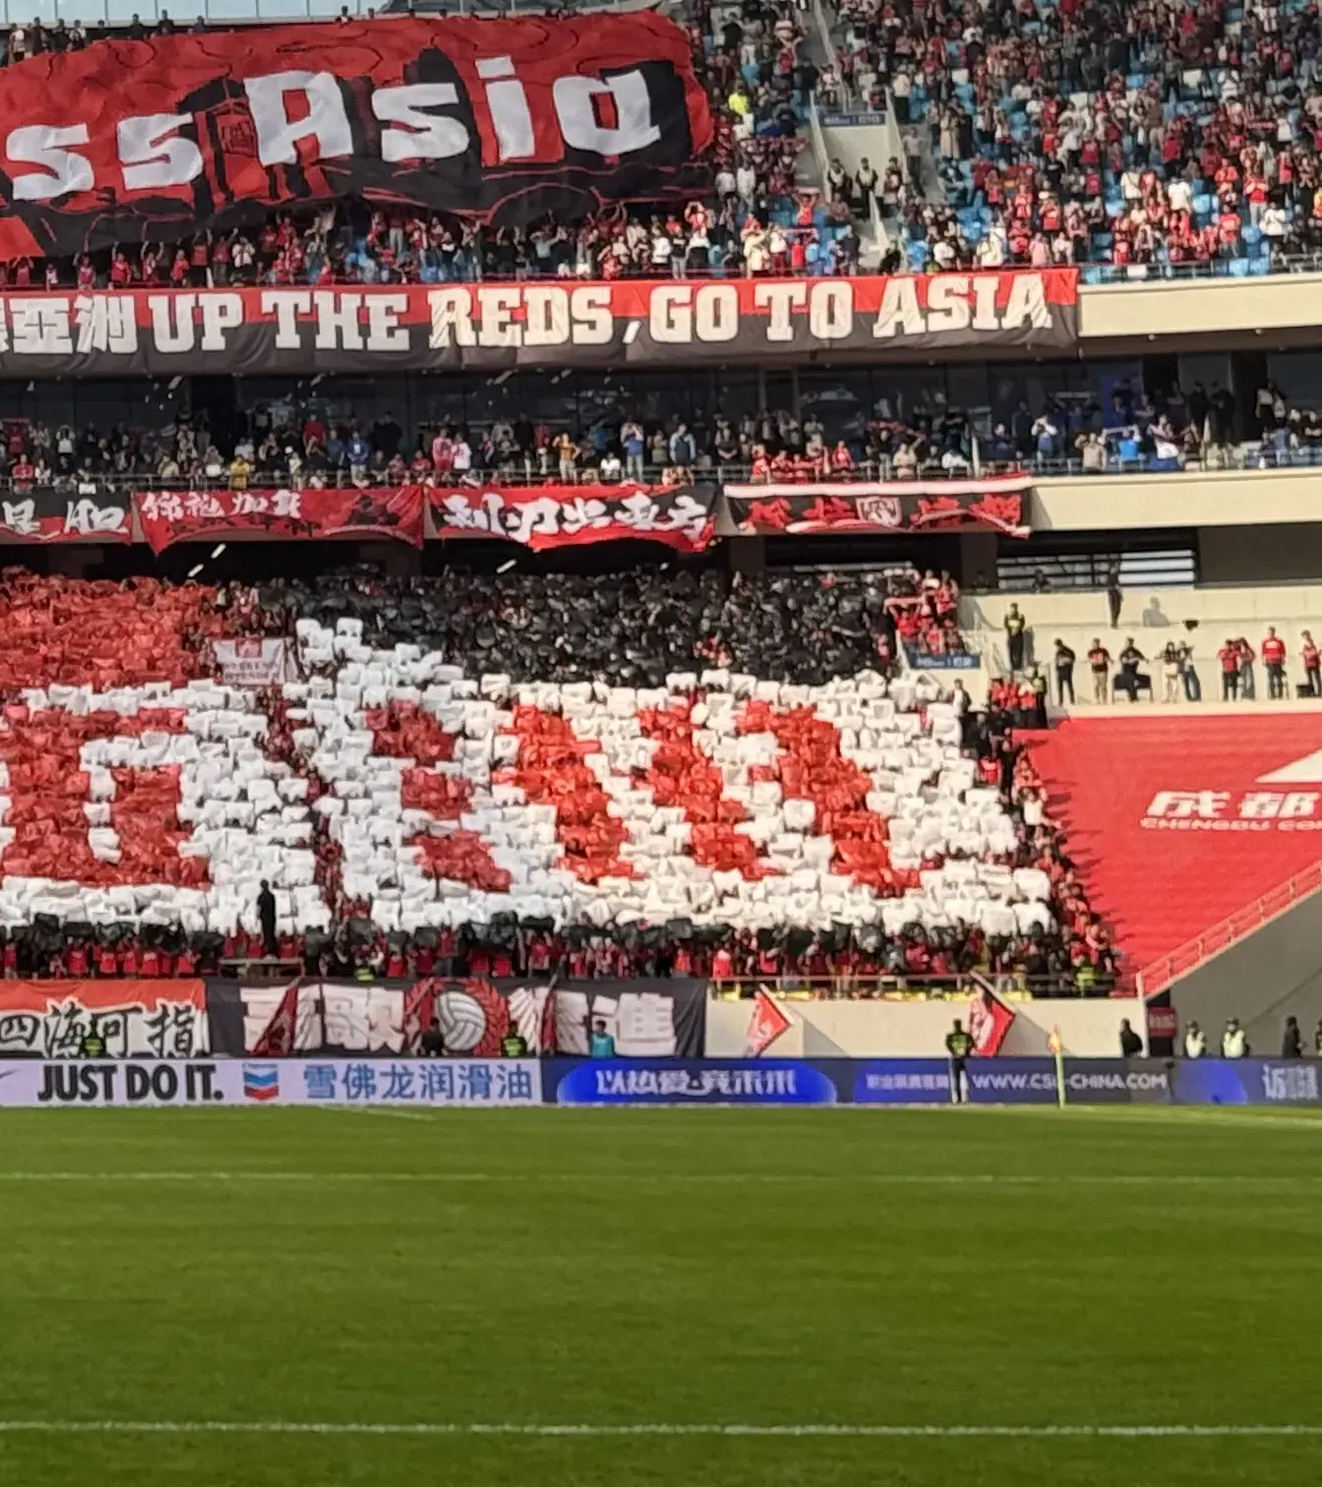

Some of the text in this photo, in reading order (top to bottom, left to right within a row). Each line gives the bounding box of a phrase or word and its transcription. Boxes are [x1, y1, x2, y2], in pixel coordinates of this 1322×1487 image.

[243, 55, 661, 166] Asia
[149, 291, 243, 353] UP
[261, 290, 409, 352] THE
[649, 285, 738, 342] GO
[756, 280, 853, 343] TO
[872, 272, 1052, 338] ASIA
[37, 1064, 224, 1101] JUST DO IT.
[304, 1063, 533, 1101] 雪佛龙润滑油
